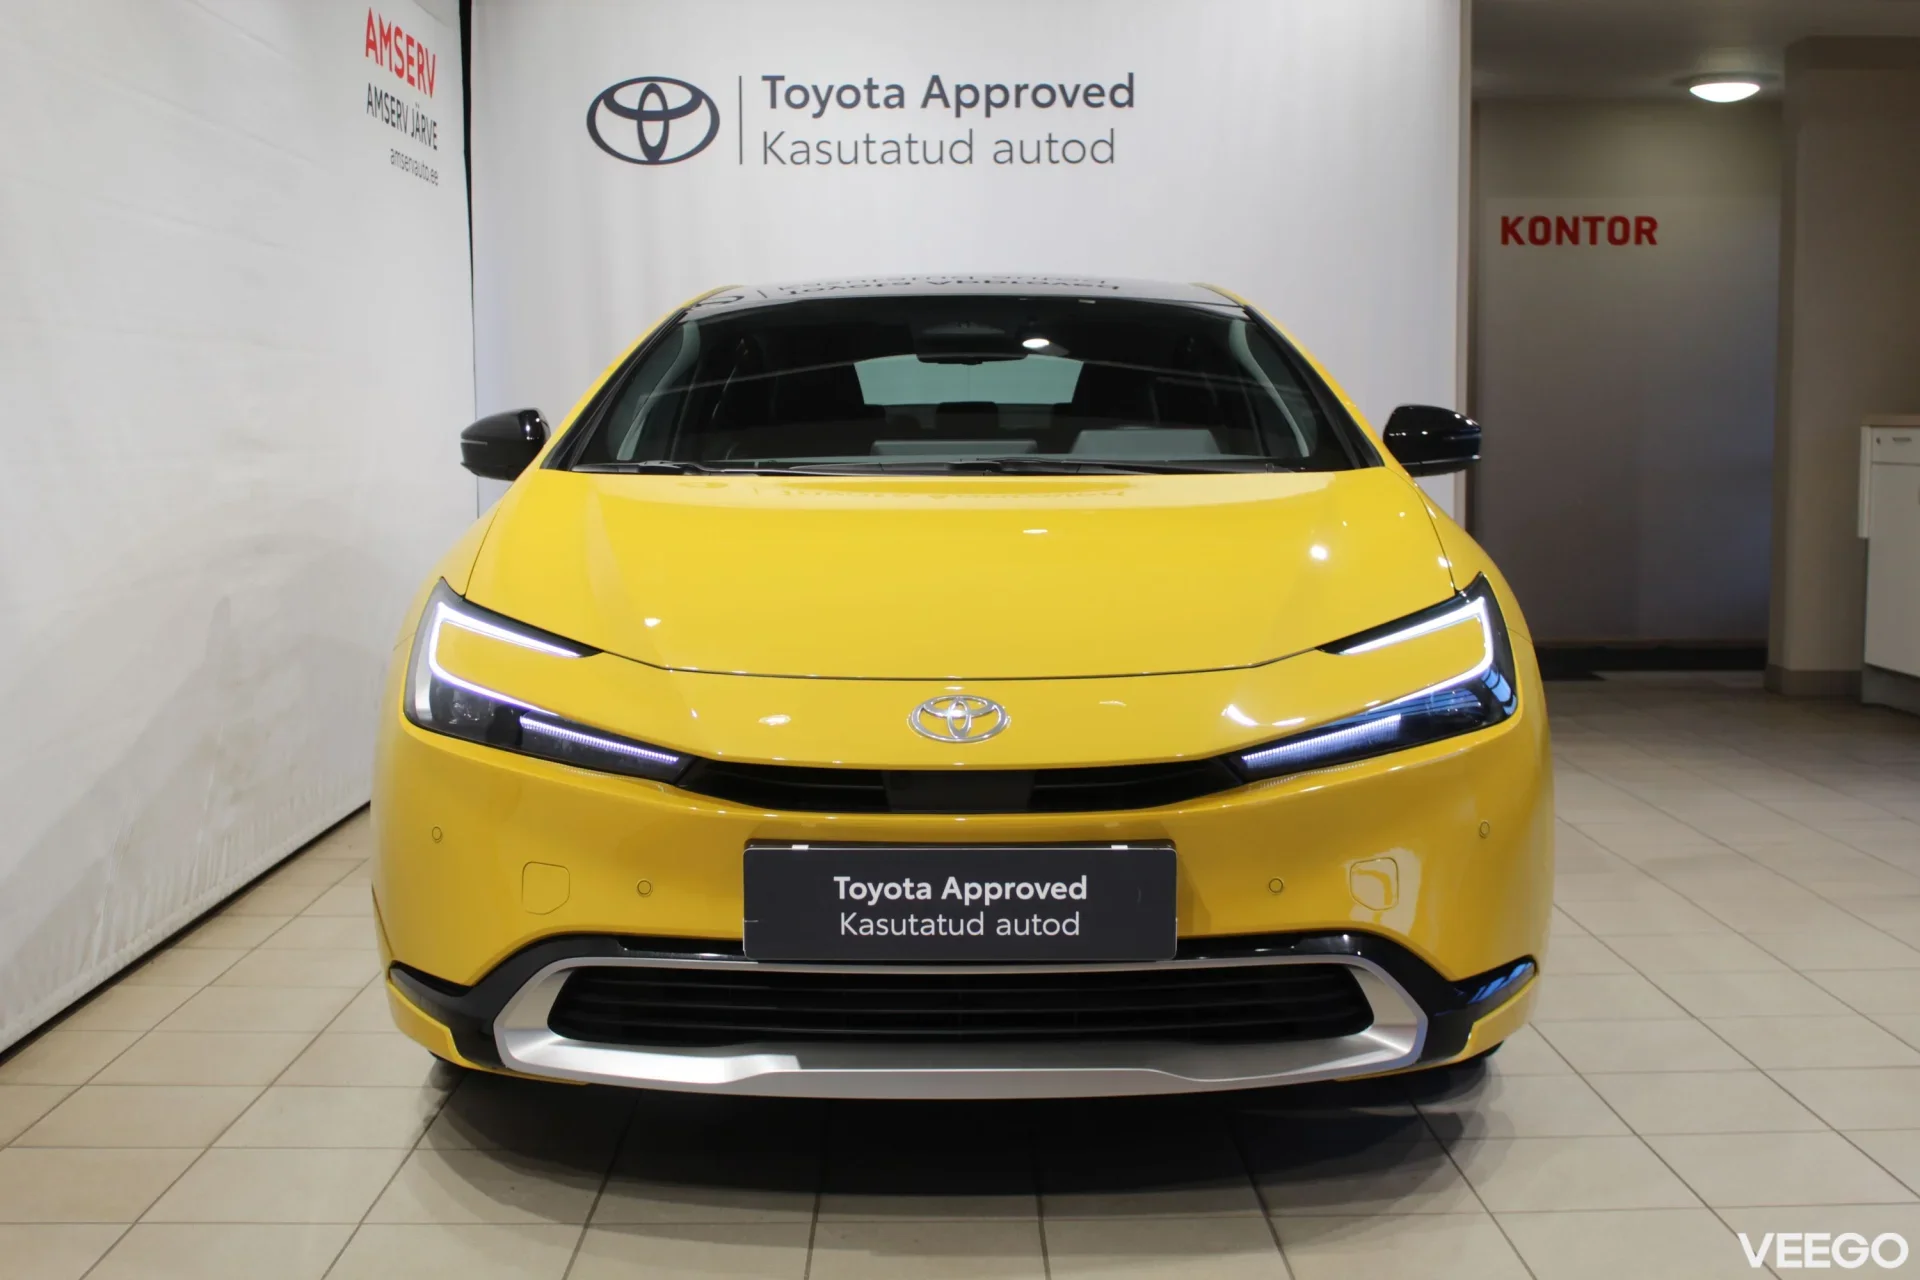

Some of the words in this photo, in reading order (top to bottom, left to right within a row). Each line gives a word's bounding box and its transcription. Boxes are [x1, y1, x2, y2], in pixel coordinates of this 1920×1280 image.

[365, 7, 436, 98] AMSERV
[762, 75, 905, 118] Toyota
[920, 72, 1135, 118] Approved
[366, 82, 409, 134] AMSERV
[410, 102, 438, 150] JÄRVE
[762, 129, 973, 165] Kasutatud
[992, 128, 1115, 165] autod
[390, 149, 439, 186] amservauto.ee
[1500, 215, 1659, 246] KONTOR
[833, 876, 932, 906] Toyota
[941, 875, 1087, 906] Approved
[840, 911, 984, 936] Kasutatud
[996, 911, 1080, 936] autod
